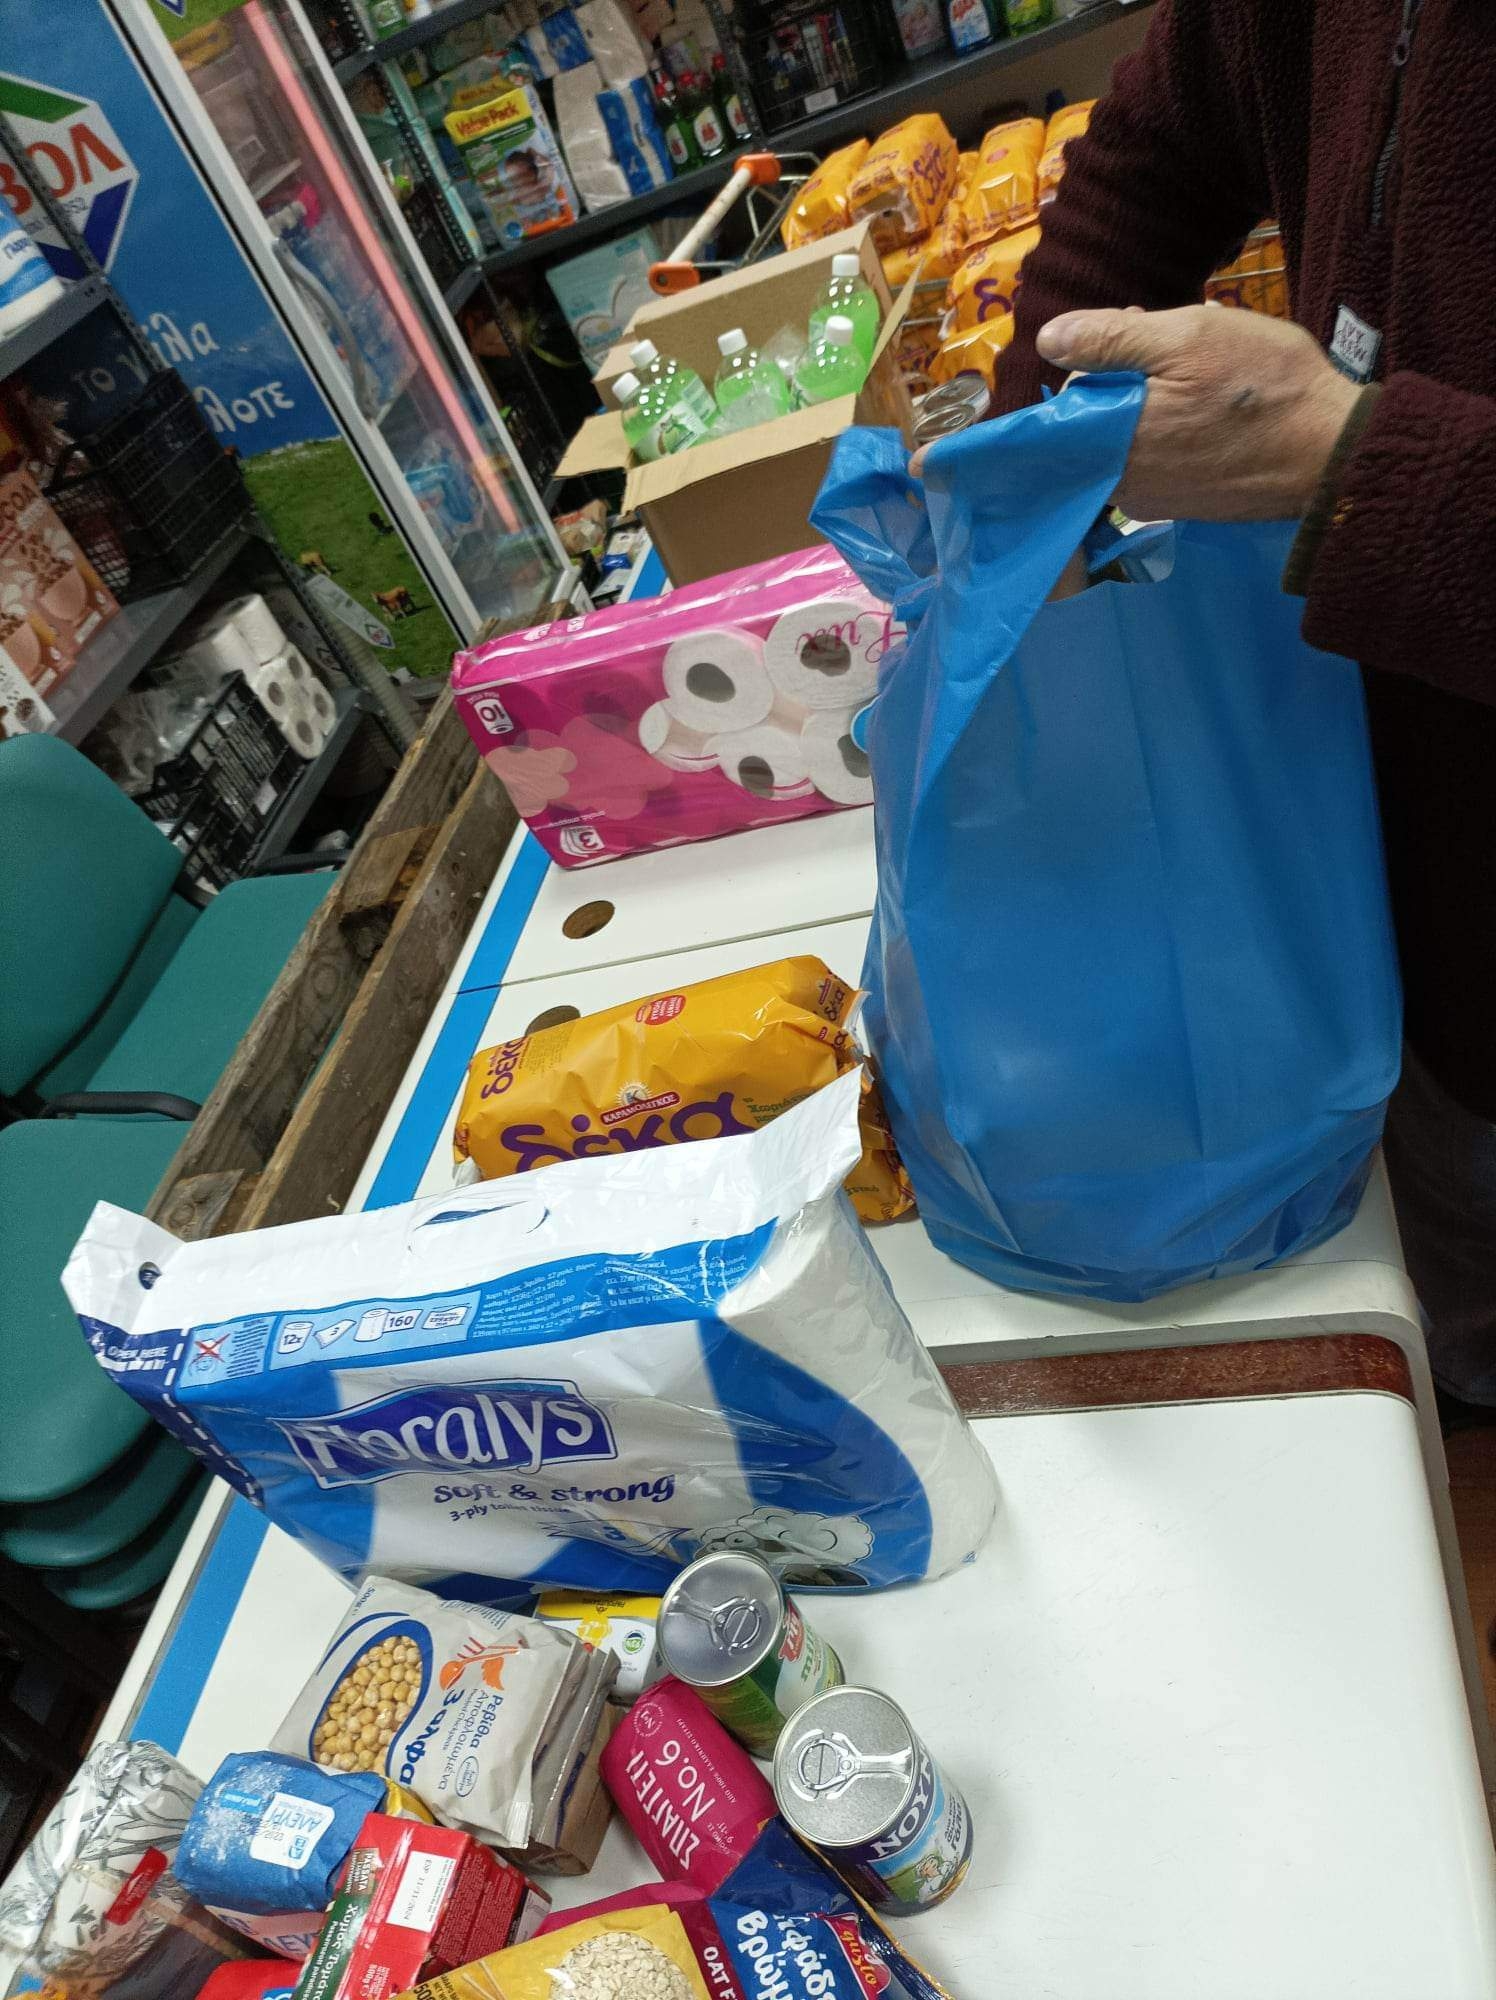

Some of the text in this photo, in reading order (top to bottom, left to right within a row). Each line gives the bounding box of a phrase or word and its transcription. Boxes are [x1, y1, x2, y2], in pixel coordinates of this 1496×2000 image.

[479, 702, 505, 724] 10
[577, 829, 601, 850] 3
[389, 1315, 414, 1329] 160
[283, 1333, 303, 1346] 12x
[302, 1393, 595, 1474] Floralys
[433, 1474, 677, 1504] soft & strong
[450, 1502, 489, 1522] 3-ply
[468, 1694, 504, 1750] Ρεβίθια
[437, 1689, 486, 1791] Αποφλοιωμένα
[268, 1806, 322, 1833] ΑΛΕΥΡΙ
[626, 1750, 701, 1871] ΣΠΑΓΓΕΤΙ
[703, 1945, 732, 1986] OAT
[839, 1929, 879, 1987] gusto
